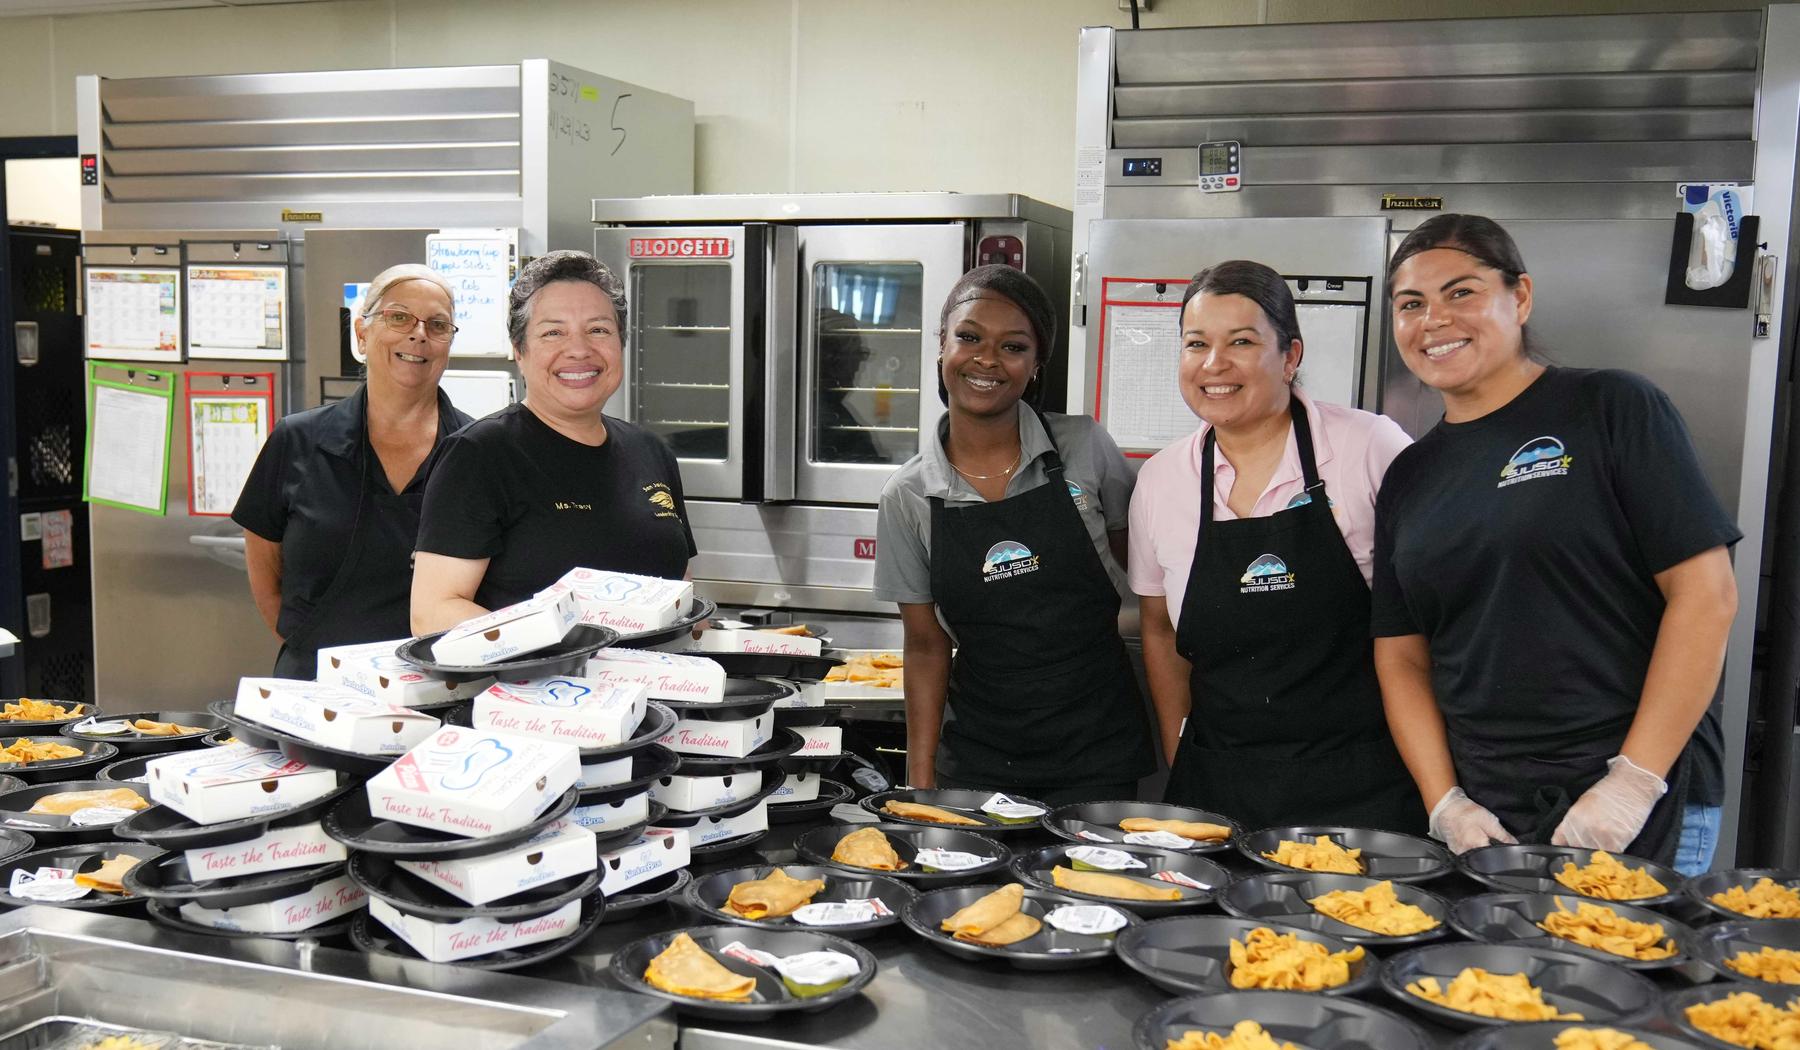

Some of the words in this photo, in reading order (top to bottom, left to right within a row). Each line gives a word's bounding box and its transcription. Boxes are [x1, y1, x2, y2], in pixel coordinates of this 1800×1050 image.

[610, 93, 632, 156] 5
[1722, 190, 1738, 240] Victoria
[633, 239, 726, 256] BLODGETT
[1505, 459, 1561, 479] SJUSD
[984, 571, 1012, 583] NUTRITION
[1013, 565, 1039, 576] SERVICES
[989, 560, 1032, 575] SJUSD
[1240, 585, 1269, 593] NUTRITION
[1270, 583, 1295, 591] SERVICES
[1246, 576, 1288, 586] SJUSD
[581, 609, 595, 623] he
[599, 610, 645, 630] Tradition
[658, 676, 710, 695] Tradition
[489, 710, 521, 729] Taste
[525, 718, 547, 733] the
[552, 719, 607, 741] Tradition
[679, 729, 729, 749] Tradition
[804, 738, 830, 751] dition
[382, 796, 412, 815] Taste
[415, 804, 435, 820] the
[439, 808, 494, 832] Tradition
[202, 852, 237, 870] Taste
[241, 848, 264, 865] the
[267, 842, 327, 861] Tradition
[431, 859, 464, 890] Tradition
[284, 905, 312, 925] Taste
[315, 897, 333, 915] the
[449, 930, 480, 951] Taste
[486, 927, 507, 944] the
[512, 918, 567, 937] Tradition
